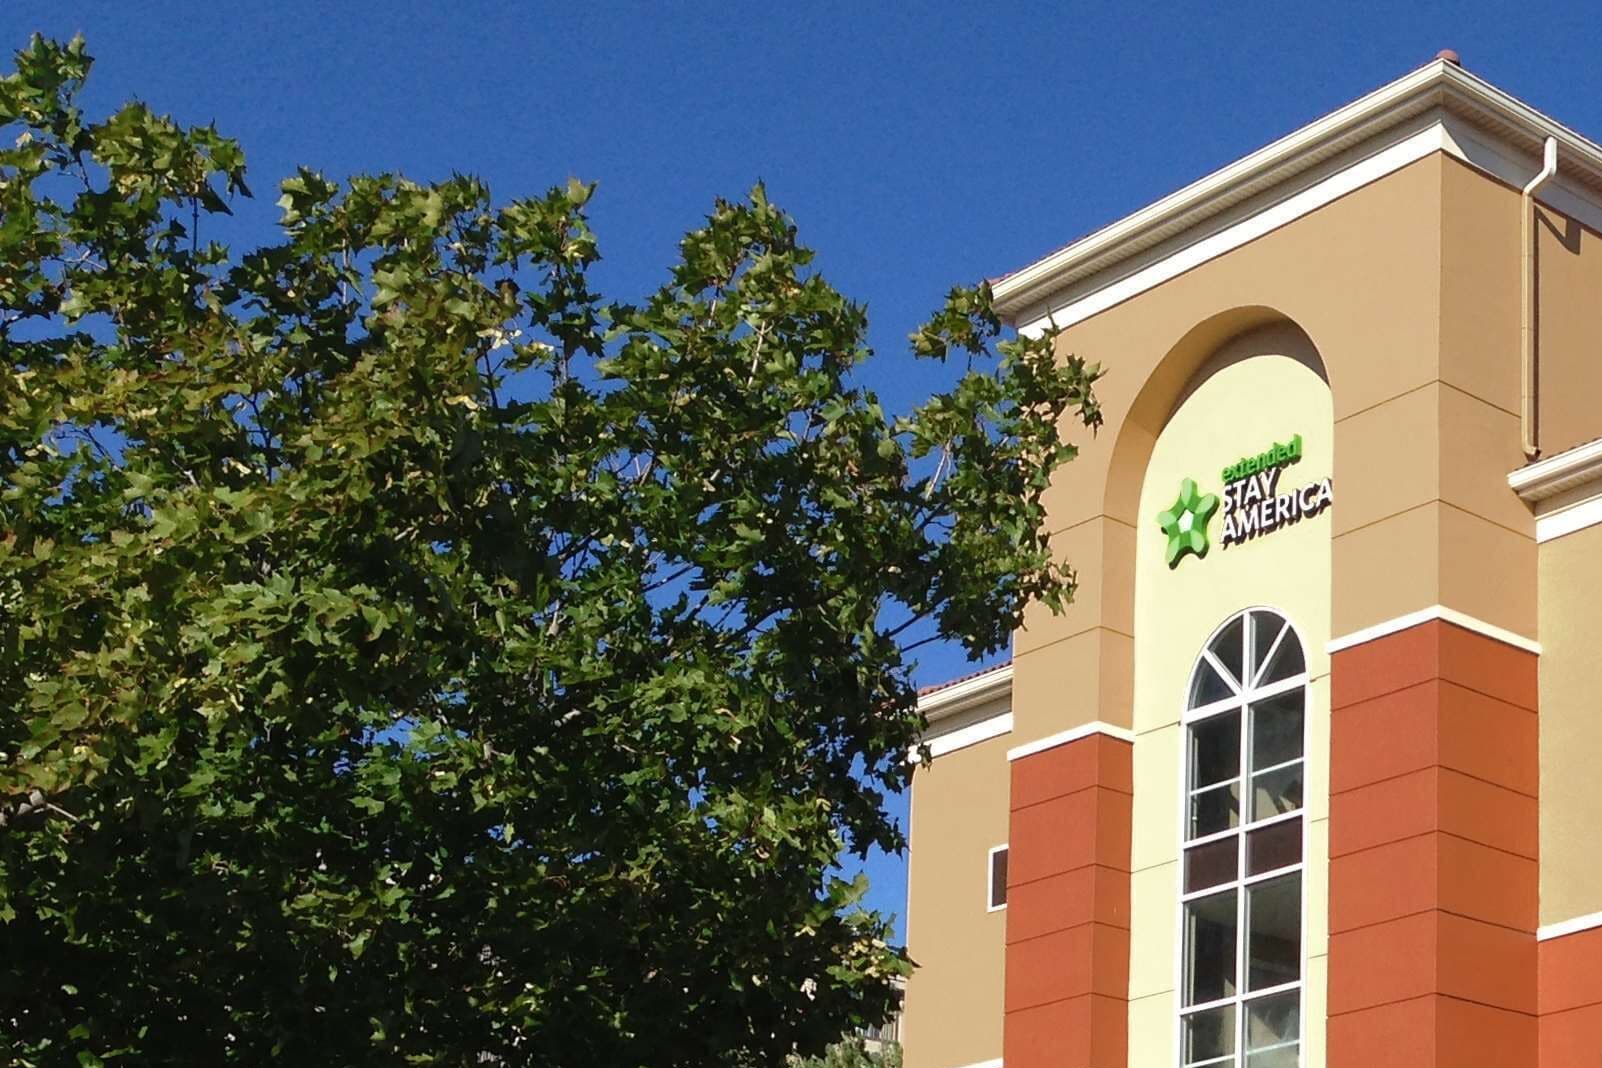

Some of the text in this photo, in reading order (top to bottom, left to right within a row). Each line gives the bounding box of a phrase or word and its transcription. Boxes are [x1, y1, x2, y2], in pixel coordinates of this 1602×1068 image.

[1221, 434, 1302, 483] extended
[1220, 477, 1333, 547] AMERICA
[1222, 467, 1280, 514] STAY
